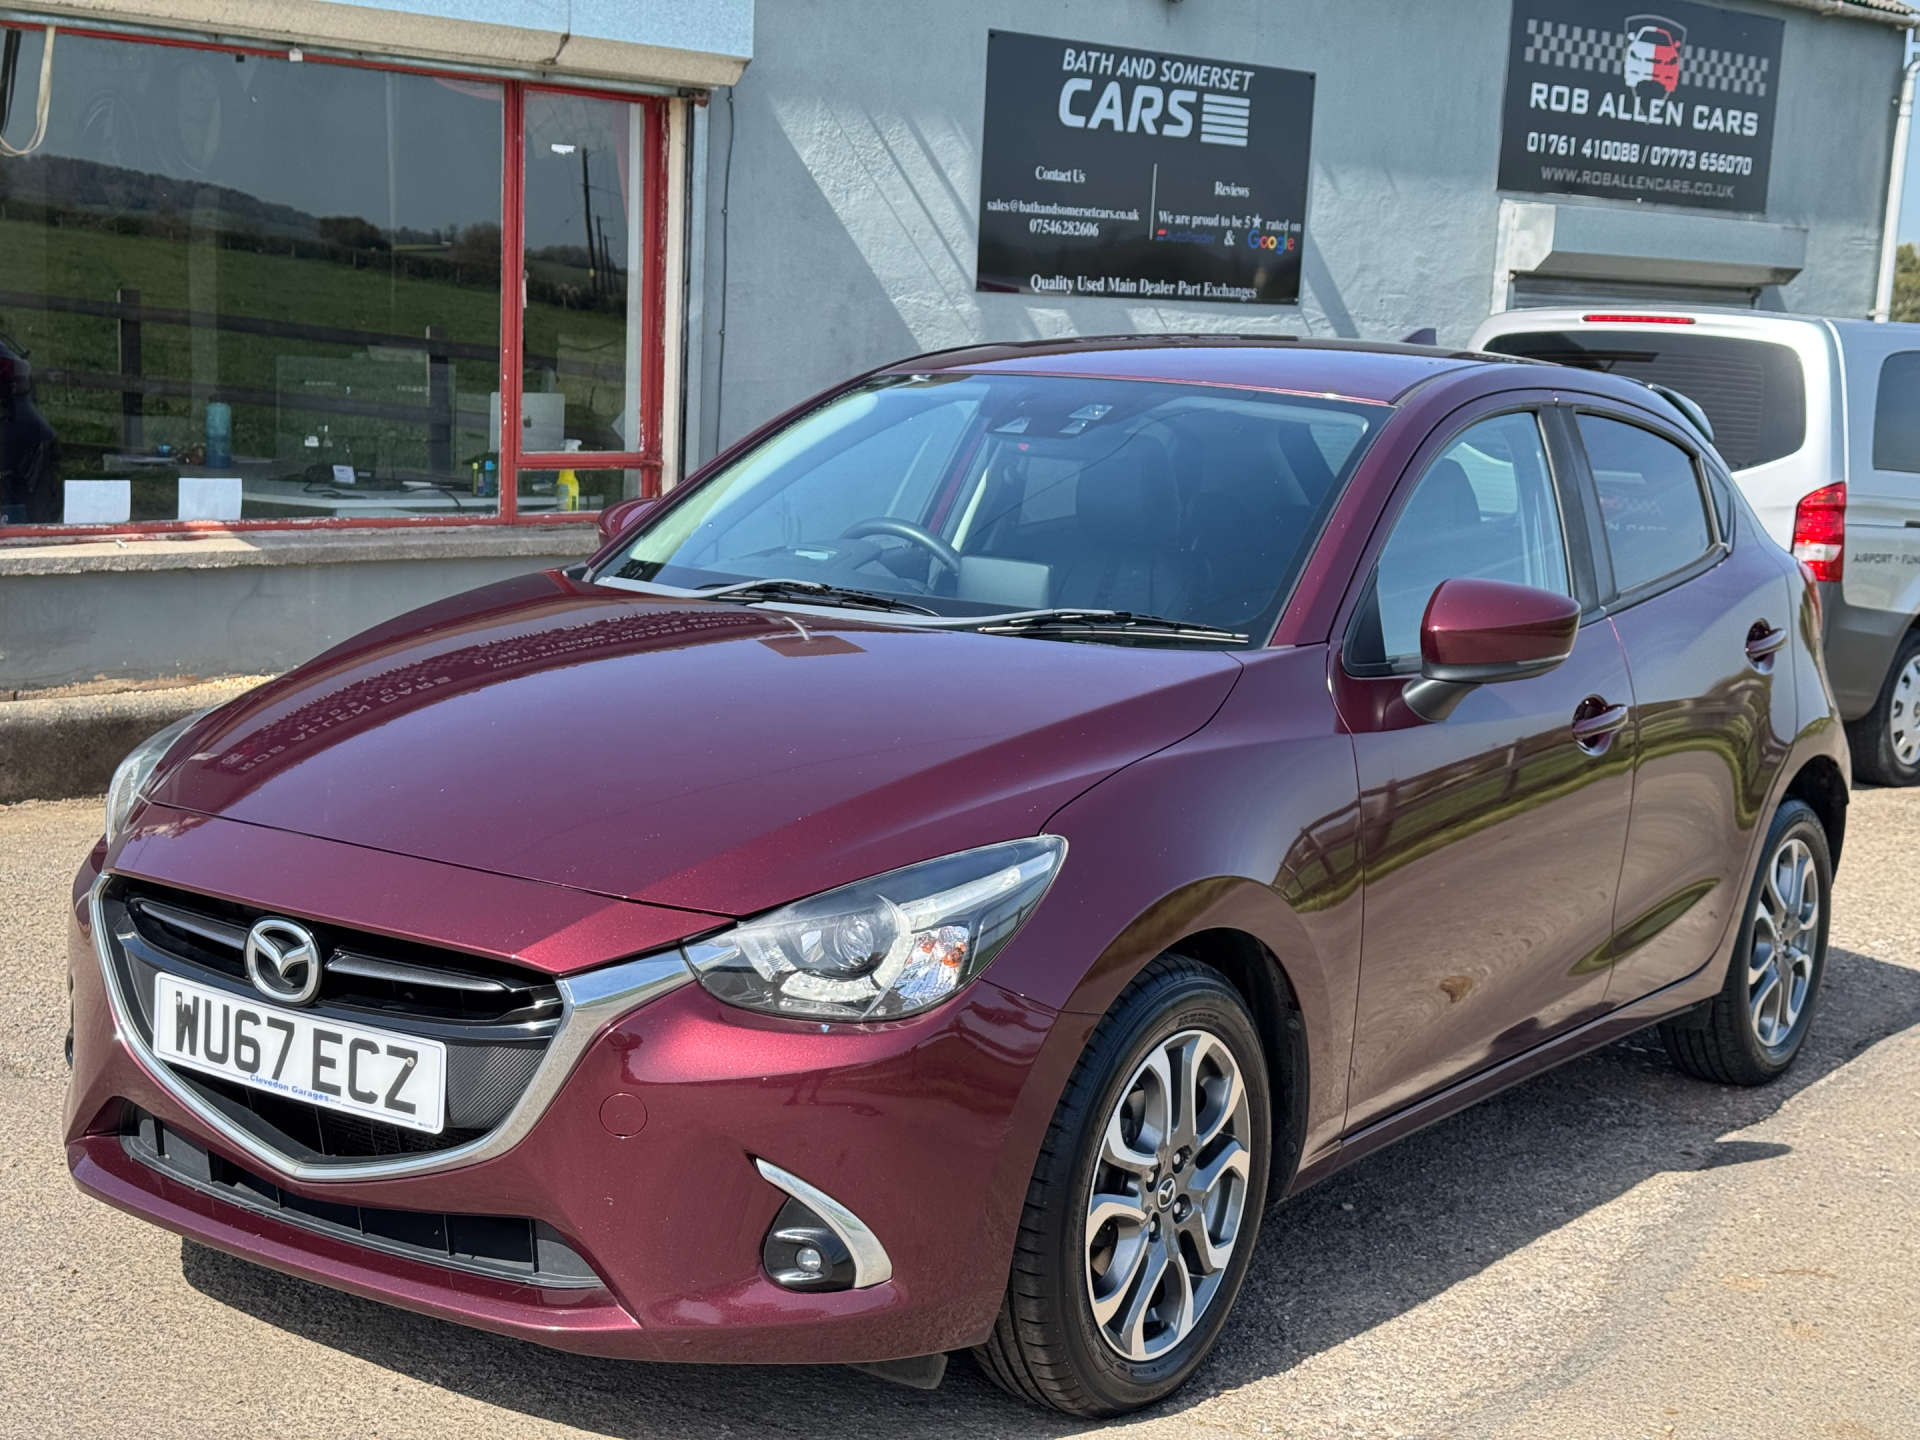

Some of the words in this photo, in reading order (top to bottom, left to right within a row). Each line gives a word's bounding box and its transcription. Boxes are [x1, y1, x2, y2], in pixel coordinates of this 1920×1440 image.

[1063, 48, 1114, 76] BATH
[1117, 56, 1156, 82] AND
[1160, 60, 1254, 92] SOMERSET
[1058, 77, 1198, 138] CARS
[1529, 82, 1590, 115] ROB
[1598, 92, 1685, 127] ALLEN
[1692, 105, 1759, 136] CARS
[1526, 132, 1576, 156] 01761
[1581, 137, 1640, 163] 410088
[1651, 146, 1696, 169] 07773
[1699, 152, 1753, 175] 656070
[1035, 166, 1072, 182] Contact
[1073, 169, 1086, 183] Us
[1540, 166, 1735, 198] WWW.ROBALLENCARS.CO.UK
[1214, 181, 1250, 198] Reviews
[1029, 218, 1099, 237] 07546282606
[1159, 210, 1174, 224] We
[1175, 214, 1190, 225] are
[1191, 214, 1219, 228] proud
[1221, 216, 1230, 226] to
[1231, 215, 1242, 227] be
[1266, 219, 1289, 231] rated
[1290, 222, 1302, 232] on
[1224, 229, 1236, 246] &
[1247, 228, 1295, 254] Google
[1030, 274, 1074, 294] Quality
[1077, 276, 1105, 292] Used
[1108, 276, 1136, 293] Main
[1139, 278, 1176, 295] Dealer
[1177, 280, 1201, 296] Part
[1203, 281, 1258, 301] Exchanges
[175, 990, 295, 1080] WU67
[312, 1028, 419, 1114] ECZ
[250, 1074, 289, 1092] Clevedon
[291, 1085, 329, 1102] Garages
